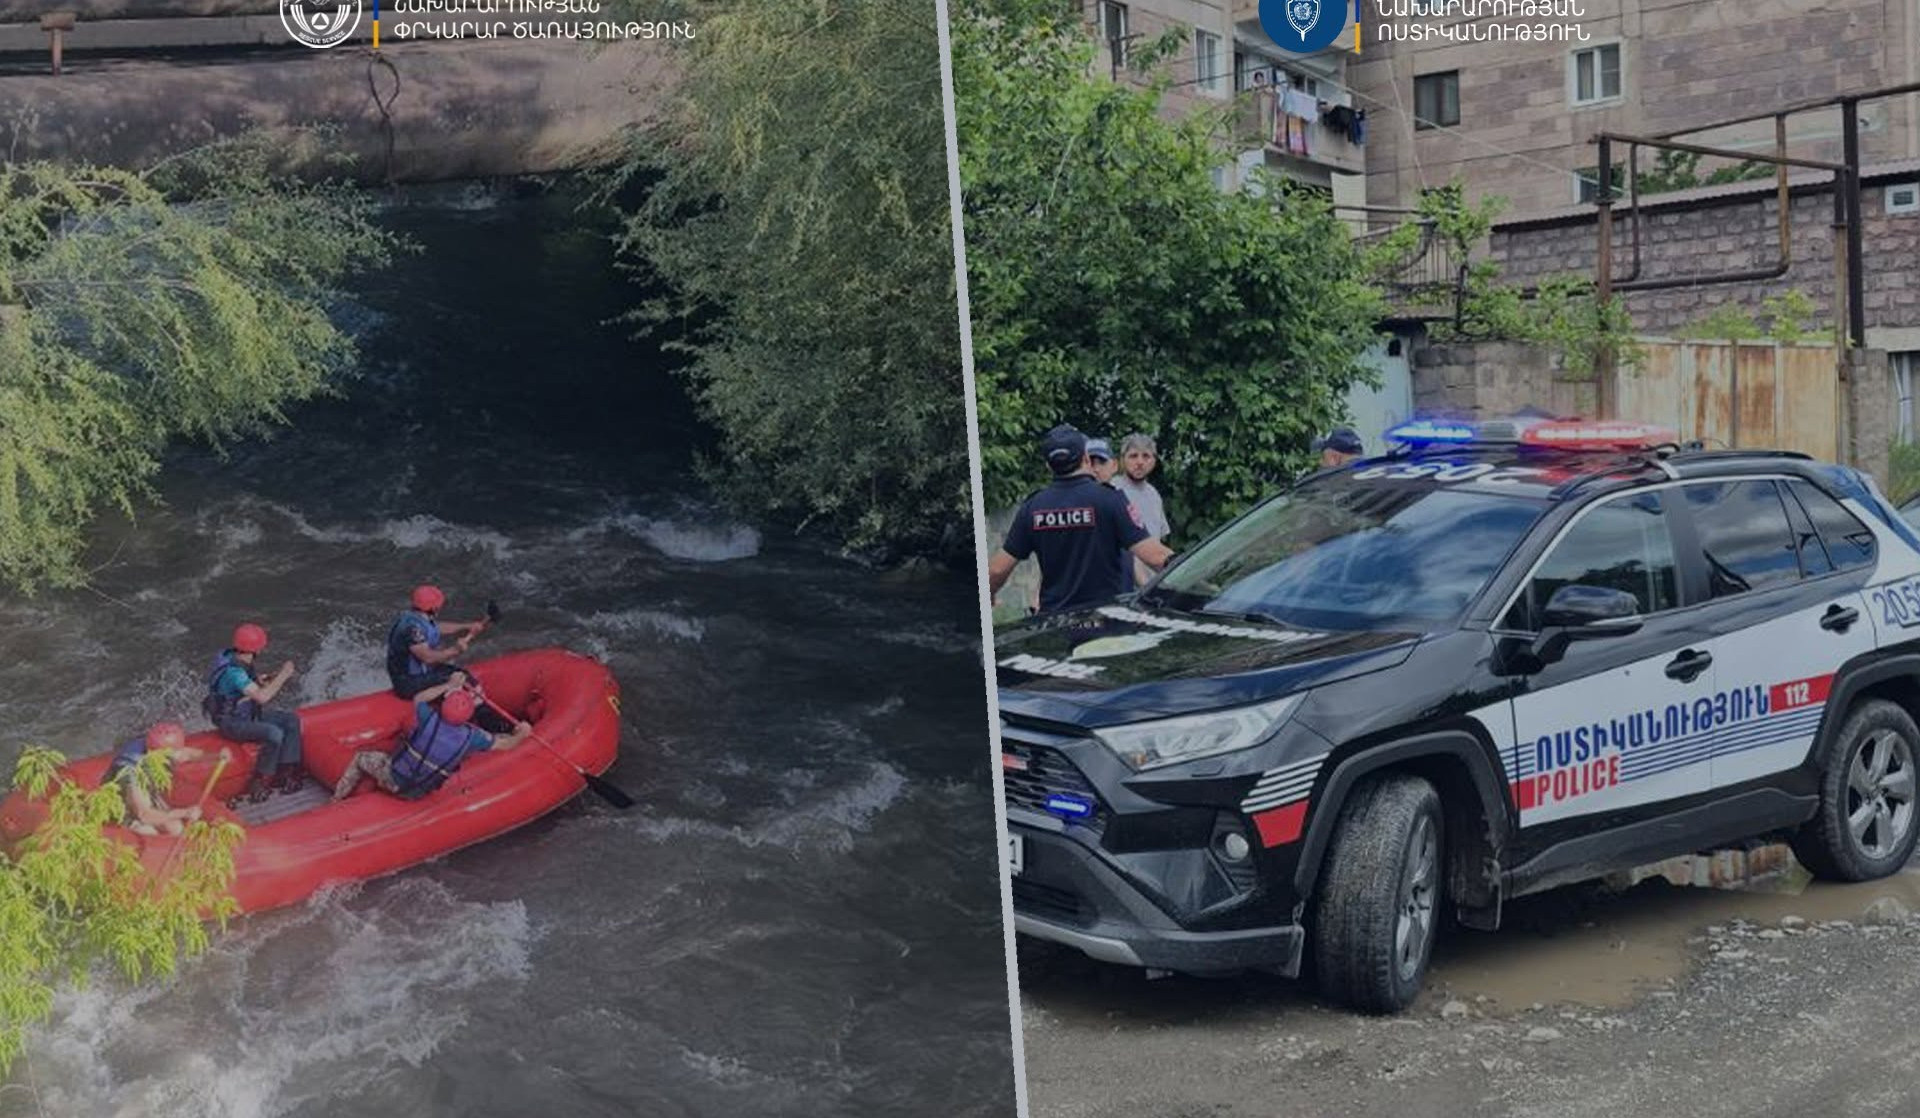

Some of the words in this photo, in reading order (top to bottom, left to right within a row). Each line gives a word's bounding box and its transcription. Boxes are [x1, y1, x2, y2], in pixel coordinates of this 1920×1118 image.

[1033, 510, 1091, 527] POLICE
[1536, 684, 1769, 772] ՈՍՏԻԿԱՆՈՒԹՅՈՒՆ
[1784, 681, 1810, 707] 112
[1537, 753, 1621, 806] POLICE
